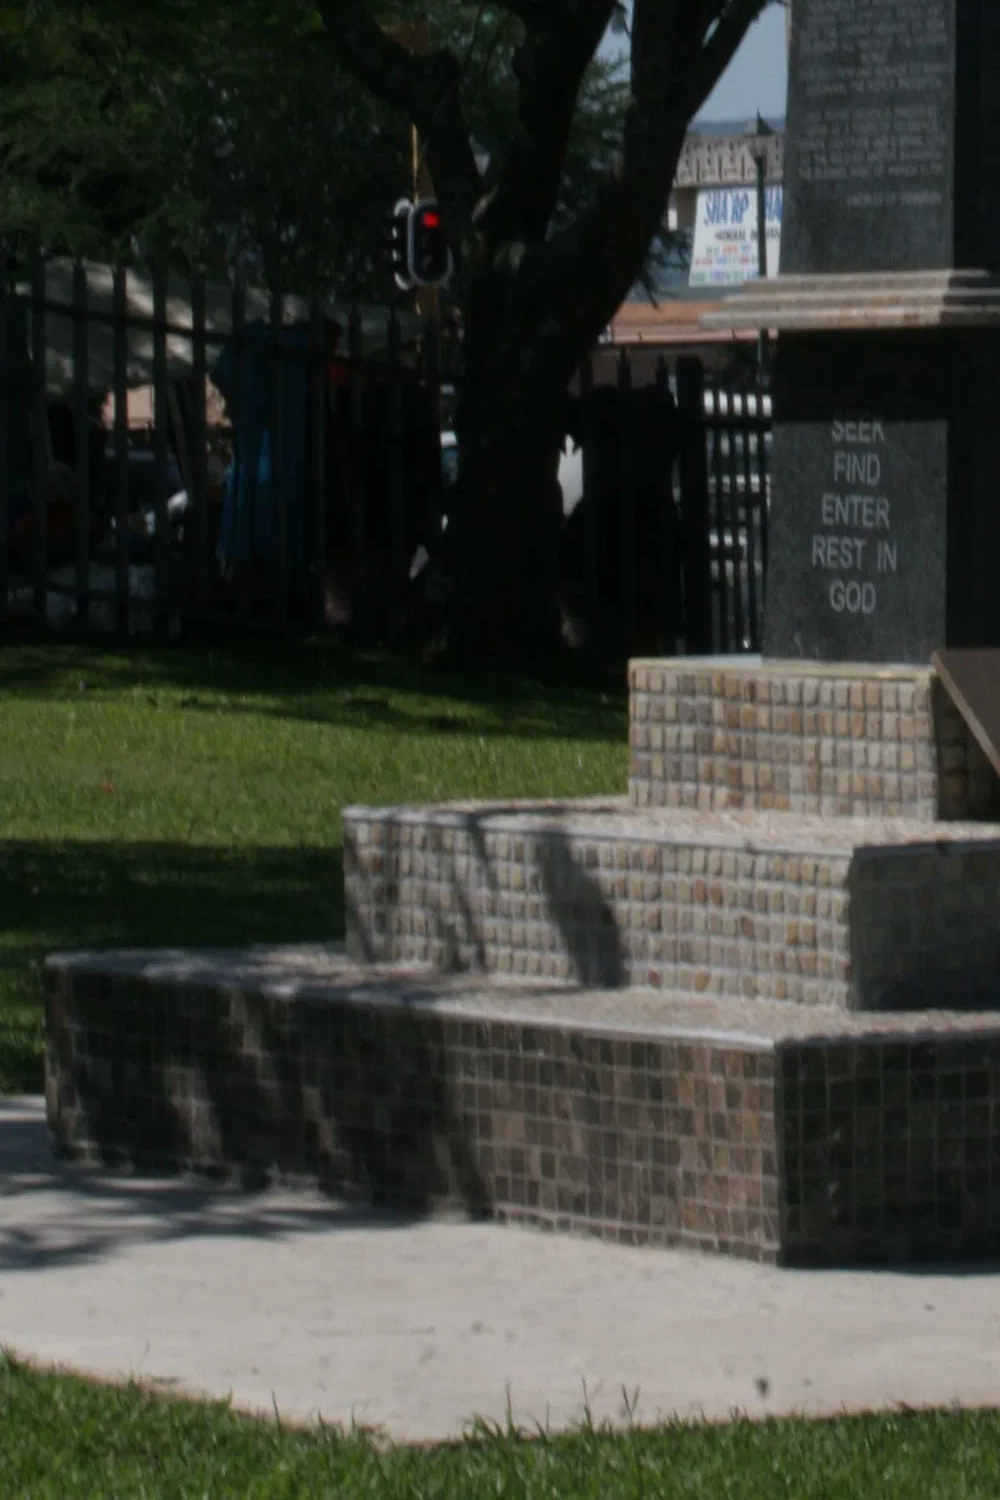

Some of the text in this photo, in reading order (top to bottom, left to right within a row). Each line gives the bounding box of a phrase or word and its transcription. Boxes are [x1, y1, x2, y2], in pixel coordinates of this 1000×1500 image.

[831, 415, 885, 444] SEEK
[833, 451, 881, 485] FIND
[821, 491, 891, 530] ENTER
[811, 533, 899, 572] REST IN
[828, 577, 877, 616] GOD
